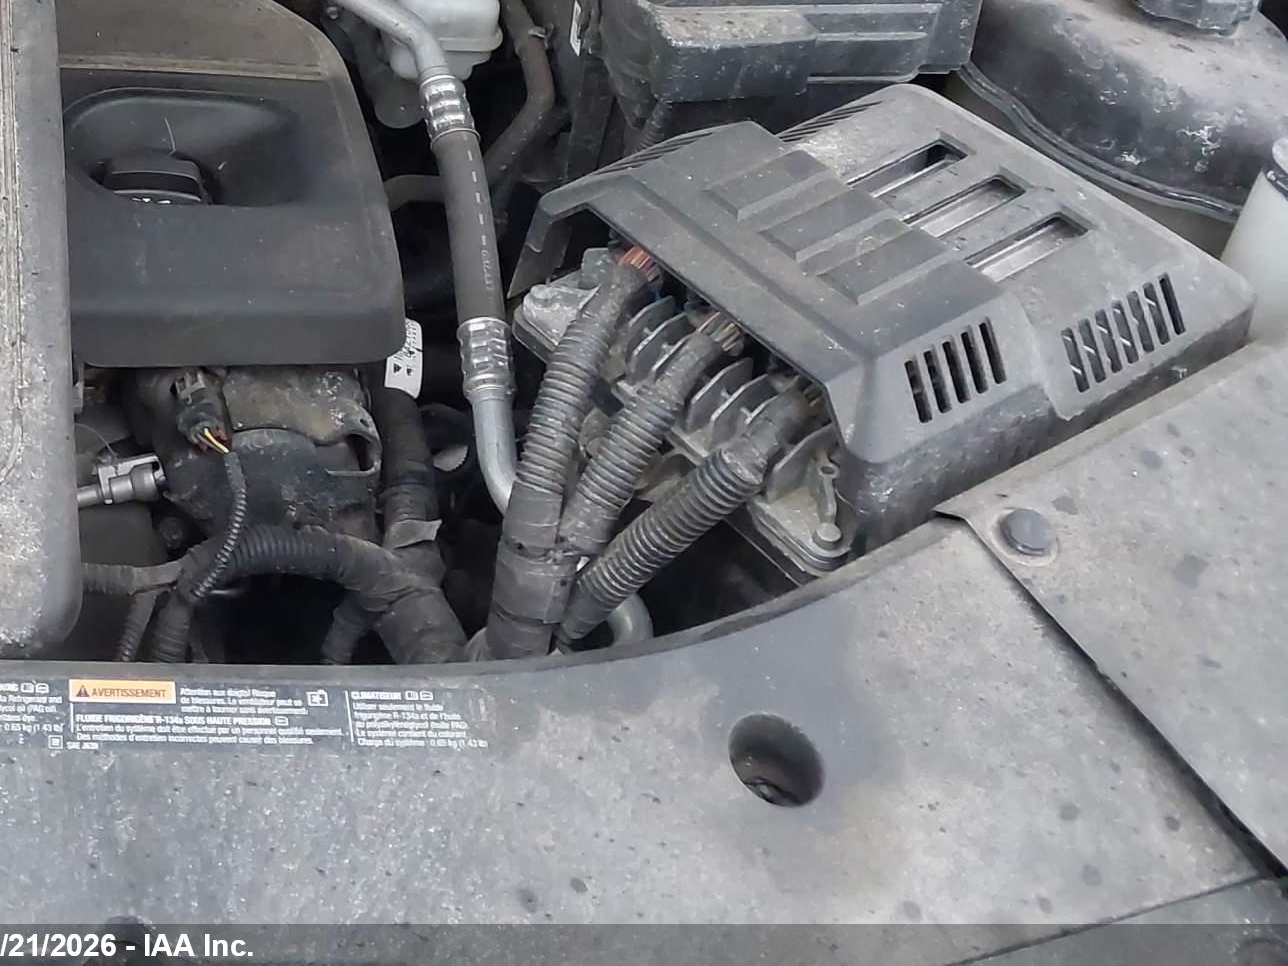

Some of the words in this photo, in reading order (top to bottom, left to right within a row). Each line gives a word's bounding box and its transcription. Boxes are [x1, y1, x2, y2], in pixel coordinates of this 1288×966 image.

[92, 688, 166, 698] AVERTISSEMENT
[76, 714, 103, 723] FLUIDE
[156, 715, 183, 725] R-134a
[185, 716, 206, 725] SOUS
[207, 716, 232, 726] HAUTE
[233, 717, 271, 726] PRESSION
[393, 711, 420, 720] R-134a
